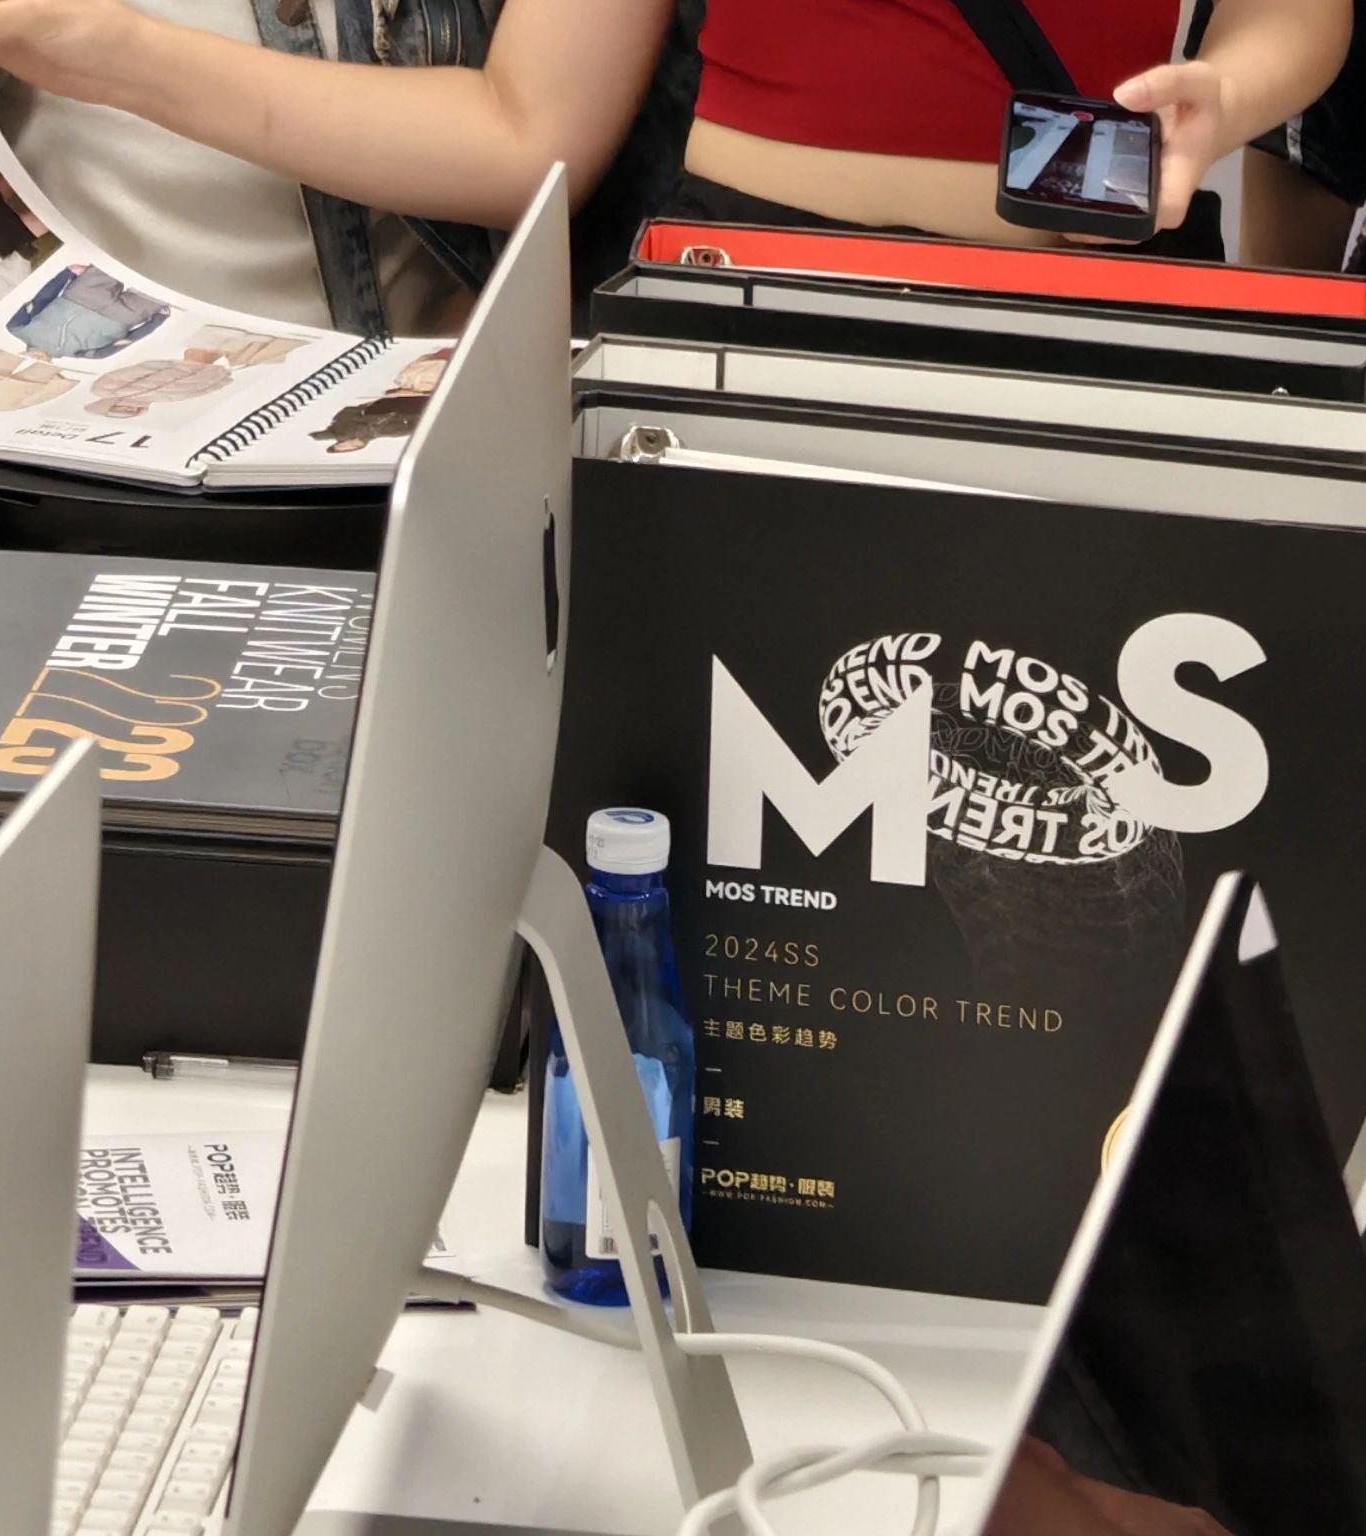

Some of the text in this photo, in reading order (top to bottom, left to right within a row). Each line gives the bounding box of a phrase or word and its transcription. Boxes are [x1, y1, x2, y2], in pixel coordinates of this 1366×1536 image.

[44, 574, 183, 672] WINTER
[157, 577, 271, 637] FALL
[216, 583, 358, 713] KNITWEAR
[962, 639, 1089, 714] MOS
[959, 671, 1078, 747] MOS
[705, 879, 838, 911] MOS TREND
[704, 933, 820, 967] 2024SS
[703, 973, 1064, 1034] THEME COLOR TREND
[703, 1018, 839, 1051] 主题色彩趋势
[702, 1096, 745, 1120] 男装
[79, 1148, 133, 1235] PROMOTES
[109, 1147, 173, 1256] INTELLIGENCE
